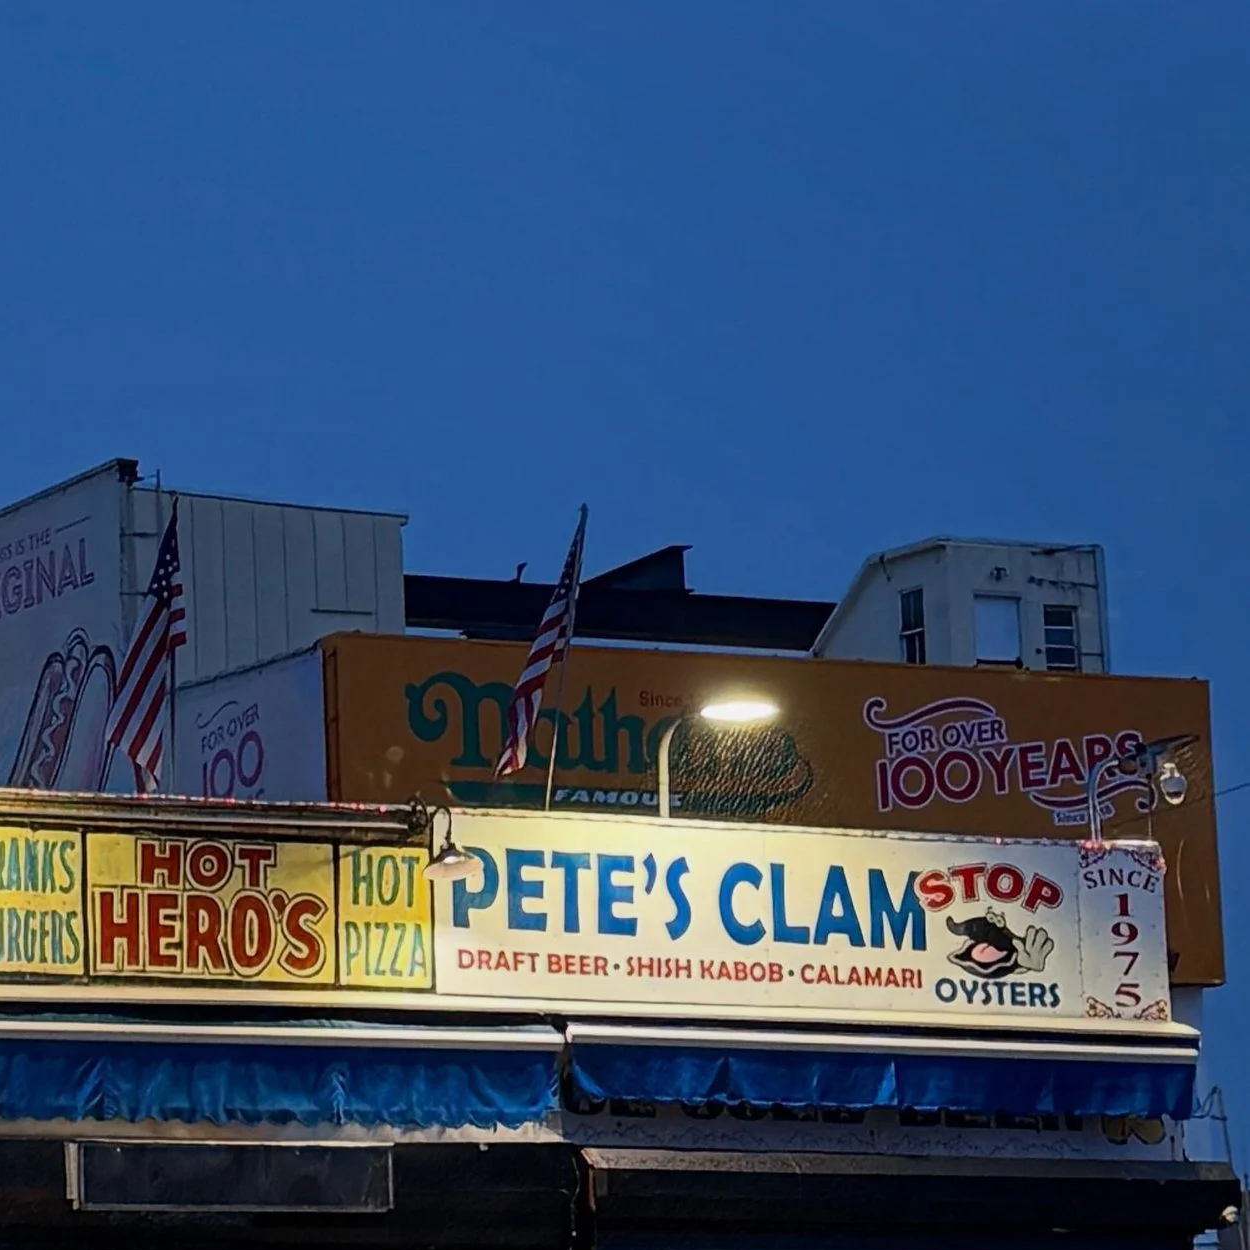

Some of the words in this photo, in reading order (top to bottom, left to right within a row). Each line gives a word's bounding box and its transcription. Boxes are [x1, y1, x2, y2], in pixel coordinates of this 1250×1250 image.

[15, 539, 25, 556] IS
[29, 528, 51, 550] THE
[201, 725, 224, 755] FOR
[227, 703, 260, 737] OVER
[888, 729, 935, 755] FOR
[942, 719, 1004, 747] OVER
[203, 731, 263, 797] 100
[878, 751, 980, 810] 100
[138, 842, 275, 888] HOT
[351, 853, 420, 907] HOT
[916, 863, 1062, 912] STOP
[1084, 868, 1160, 893] SINCE
[452, 846, 692, 941] PETE'S
[718, 862, 928, 951] CLAM
[97, 889, 326, 976] HERO'S
[344, 921, 428, 977] PIZZA
[1111, 893, 1141, 1008] 1975
[457, 949, 539, 973] DRAFT
[547, 953, 608, 976] BEER
[626, 957, 692, 979] SHISH
[700, 960, 783, 983] KABOB
[801, 964, 923, 989] CALAMARI
[935, 978, 1060, 1008] OYSTERS
